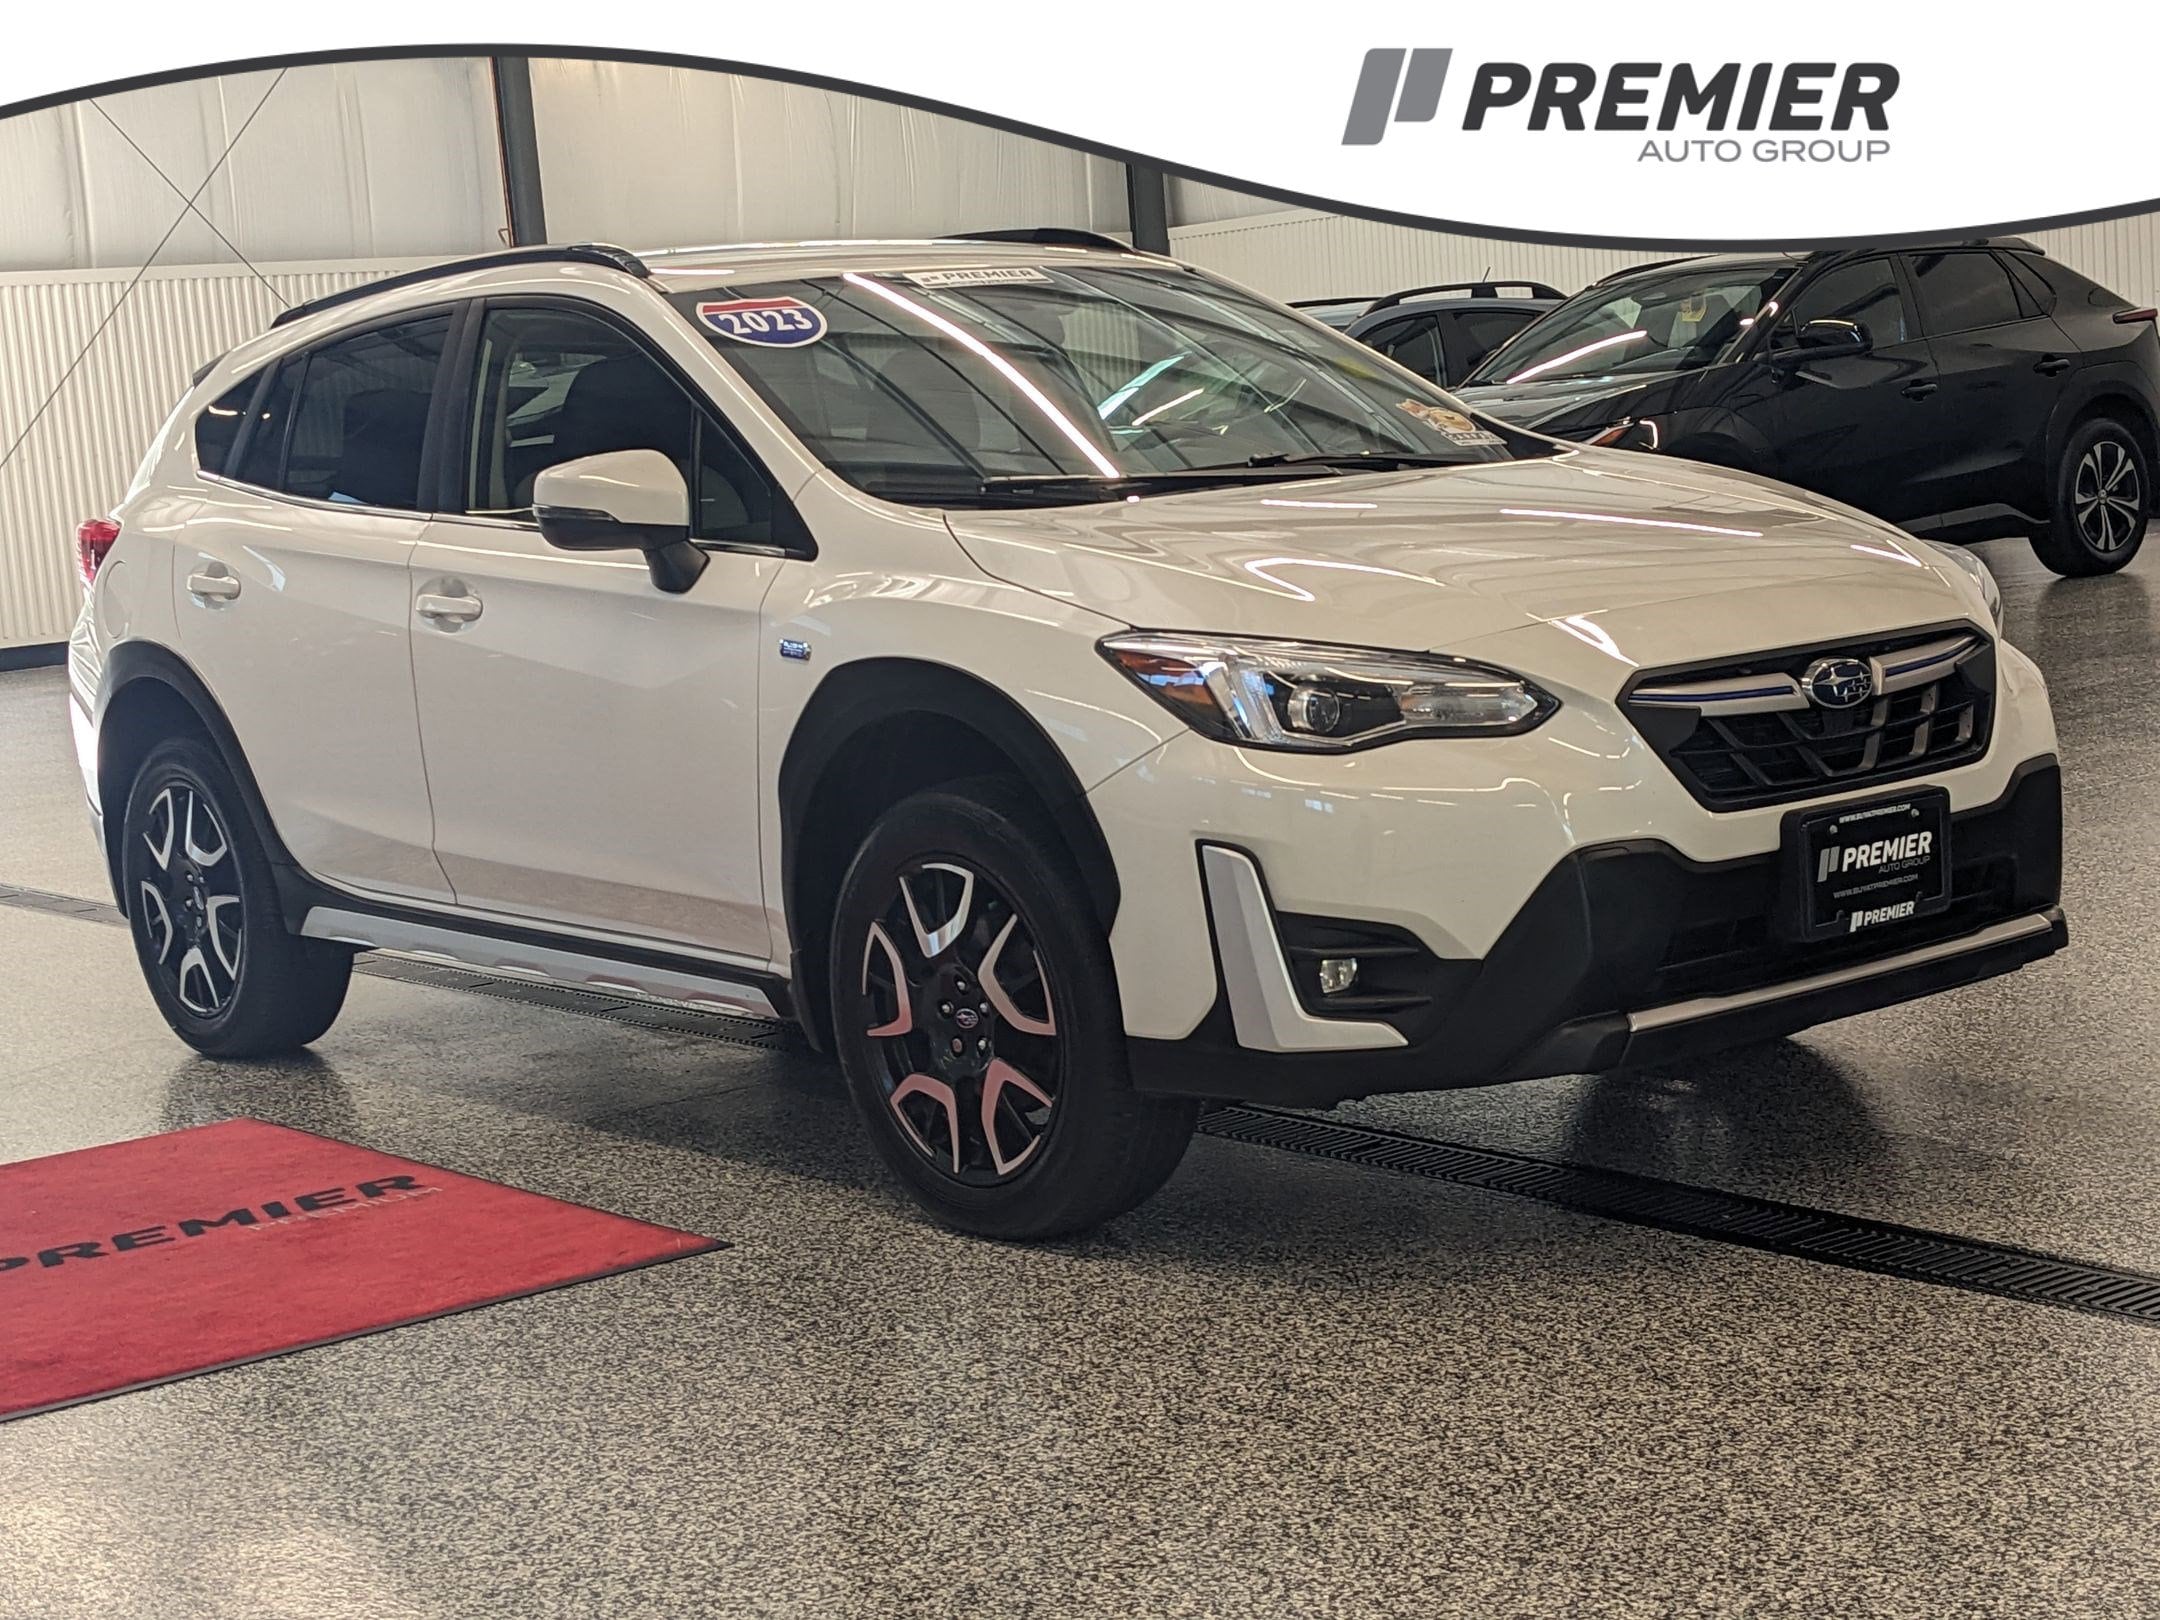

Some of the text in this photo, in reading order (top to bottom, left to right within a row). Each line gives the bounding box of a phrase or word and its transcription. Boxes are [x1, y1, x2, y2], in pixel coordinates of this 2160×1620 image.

[940, 269, 1034, 281] PREMIER
[718, 308, 813, 335] 2023
[1842, 831, 1933, 873] PREMIER
[1878, 855, 1931, 874] AUTO GROUP
[1863, 900, 1915, 927] PREMIER
